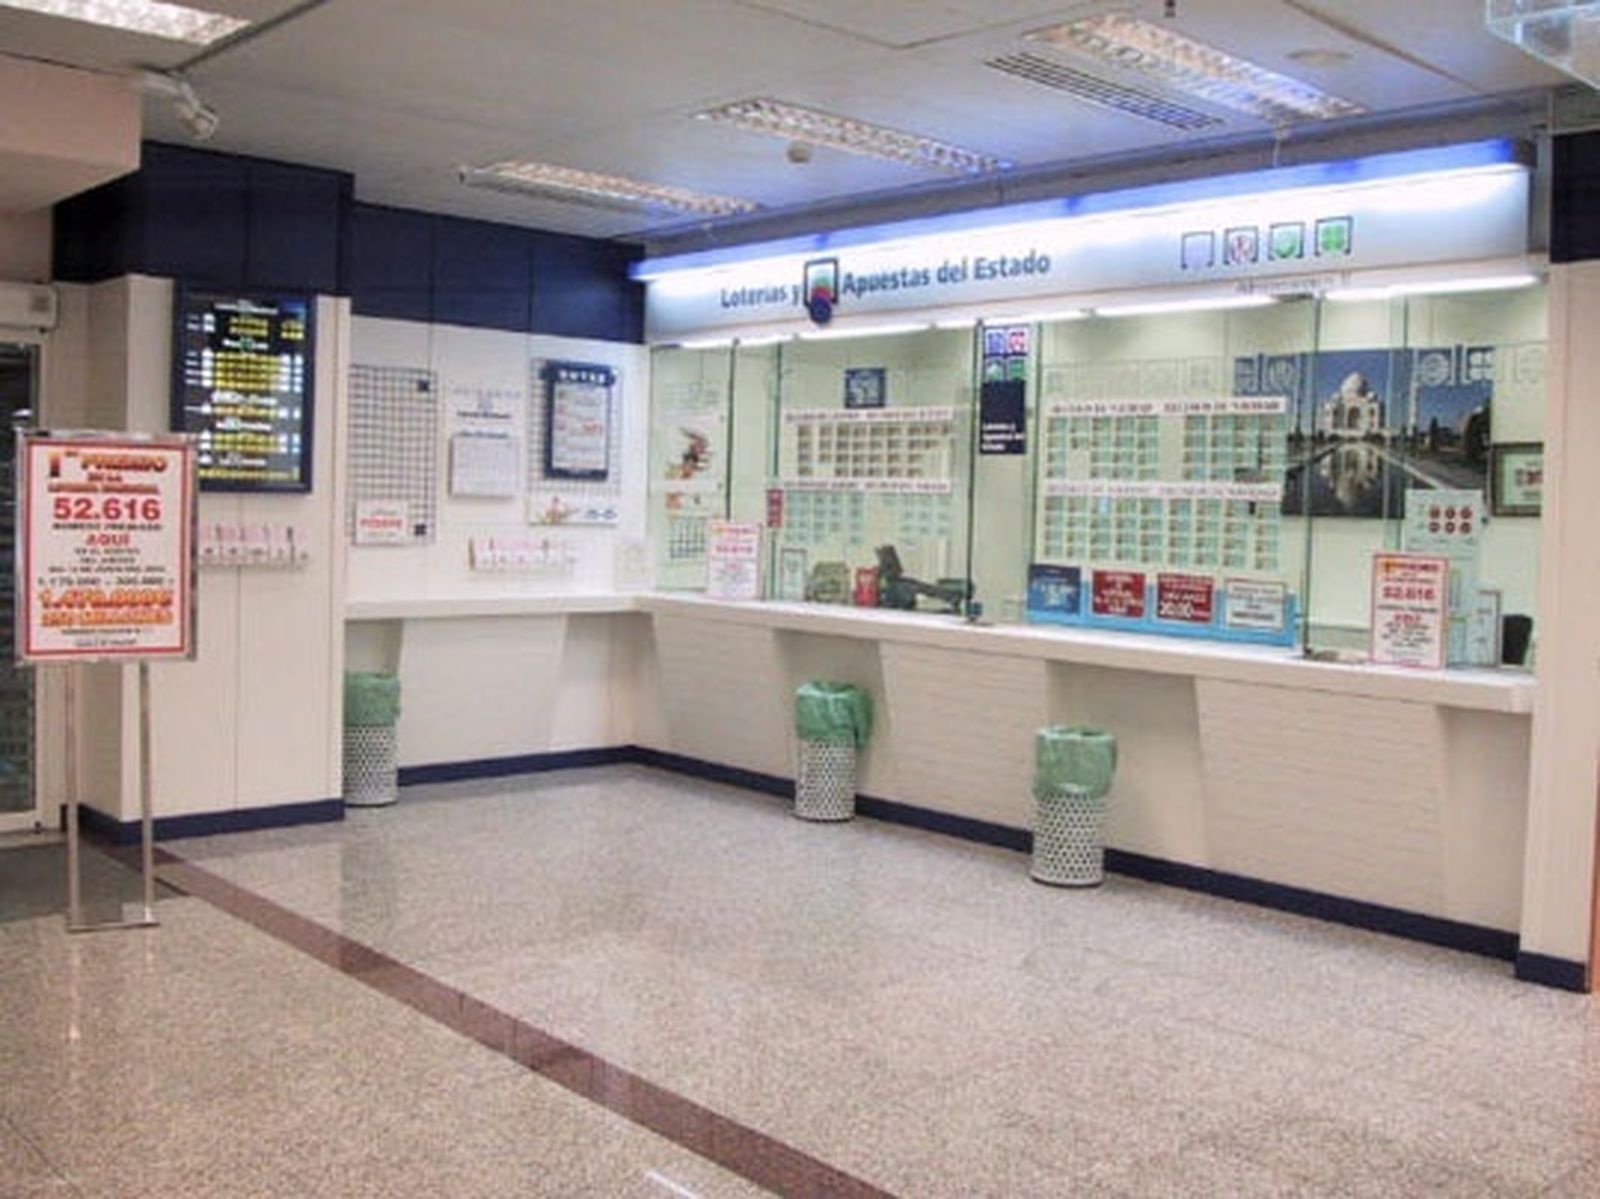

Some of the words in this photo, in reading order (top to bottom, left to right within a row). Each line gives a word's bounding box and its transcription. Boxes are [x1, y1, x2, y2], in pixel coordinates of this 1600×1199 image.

[791, 285, 800, 307] y
[841, 266, 930, 299] Apuestas
[936, 256, 968, 284] del
[973, 249, 1050, 281] Estado
[53, 497, 161, 521] 52.616
